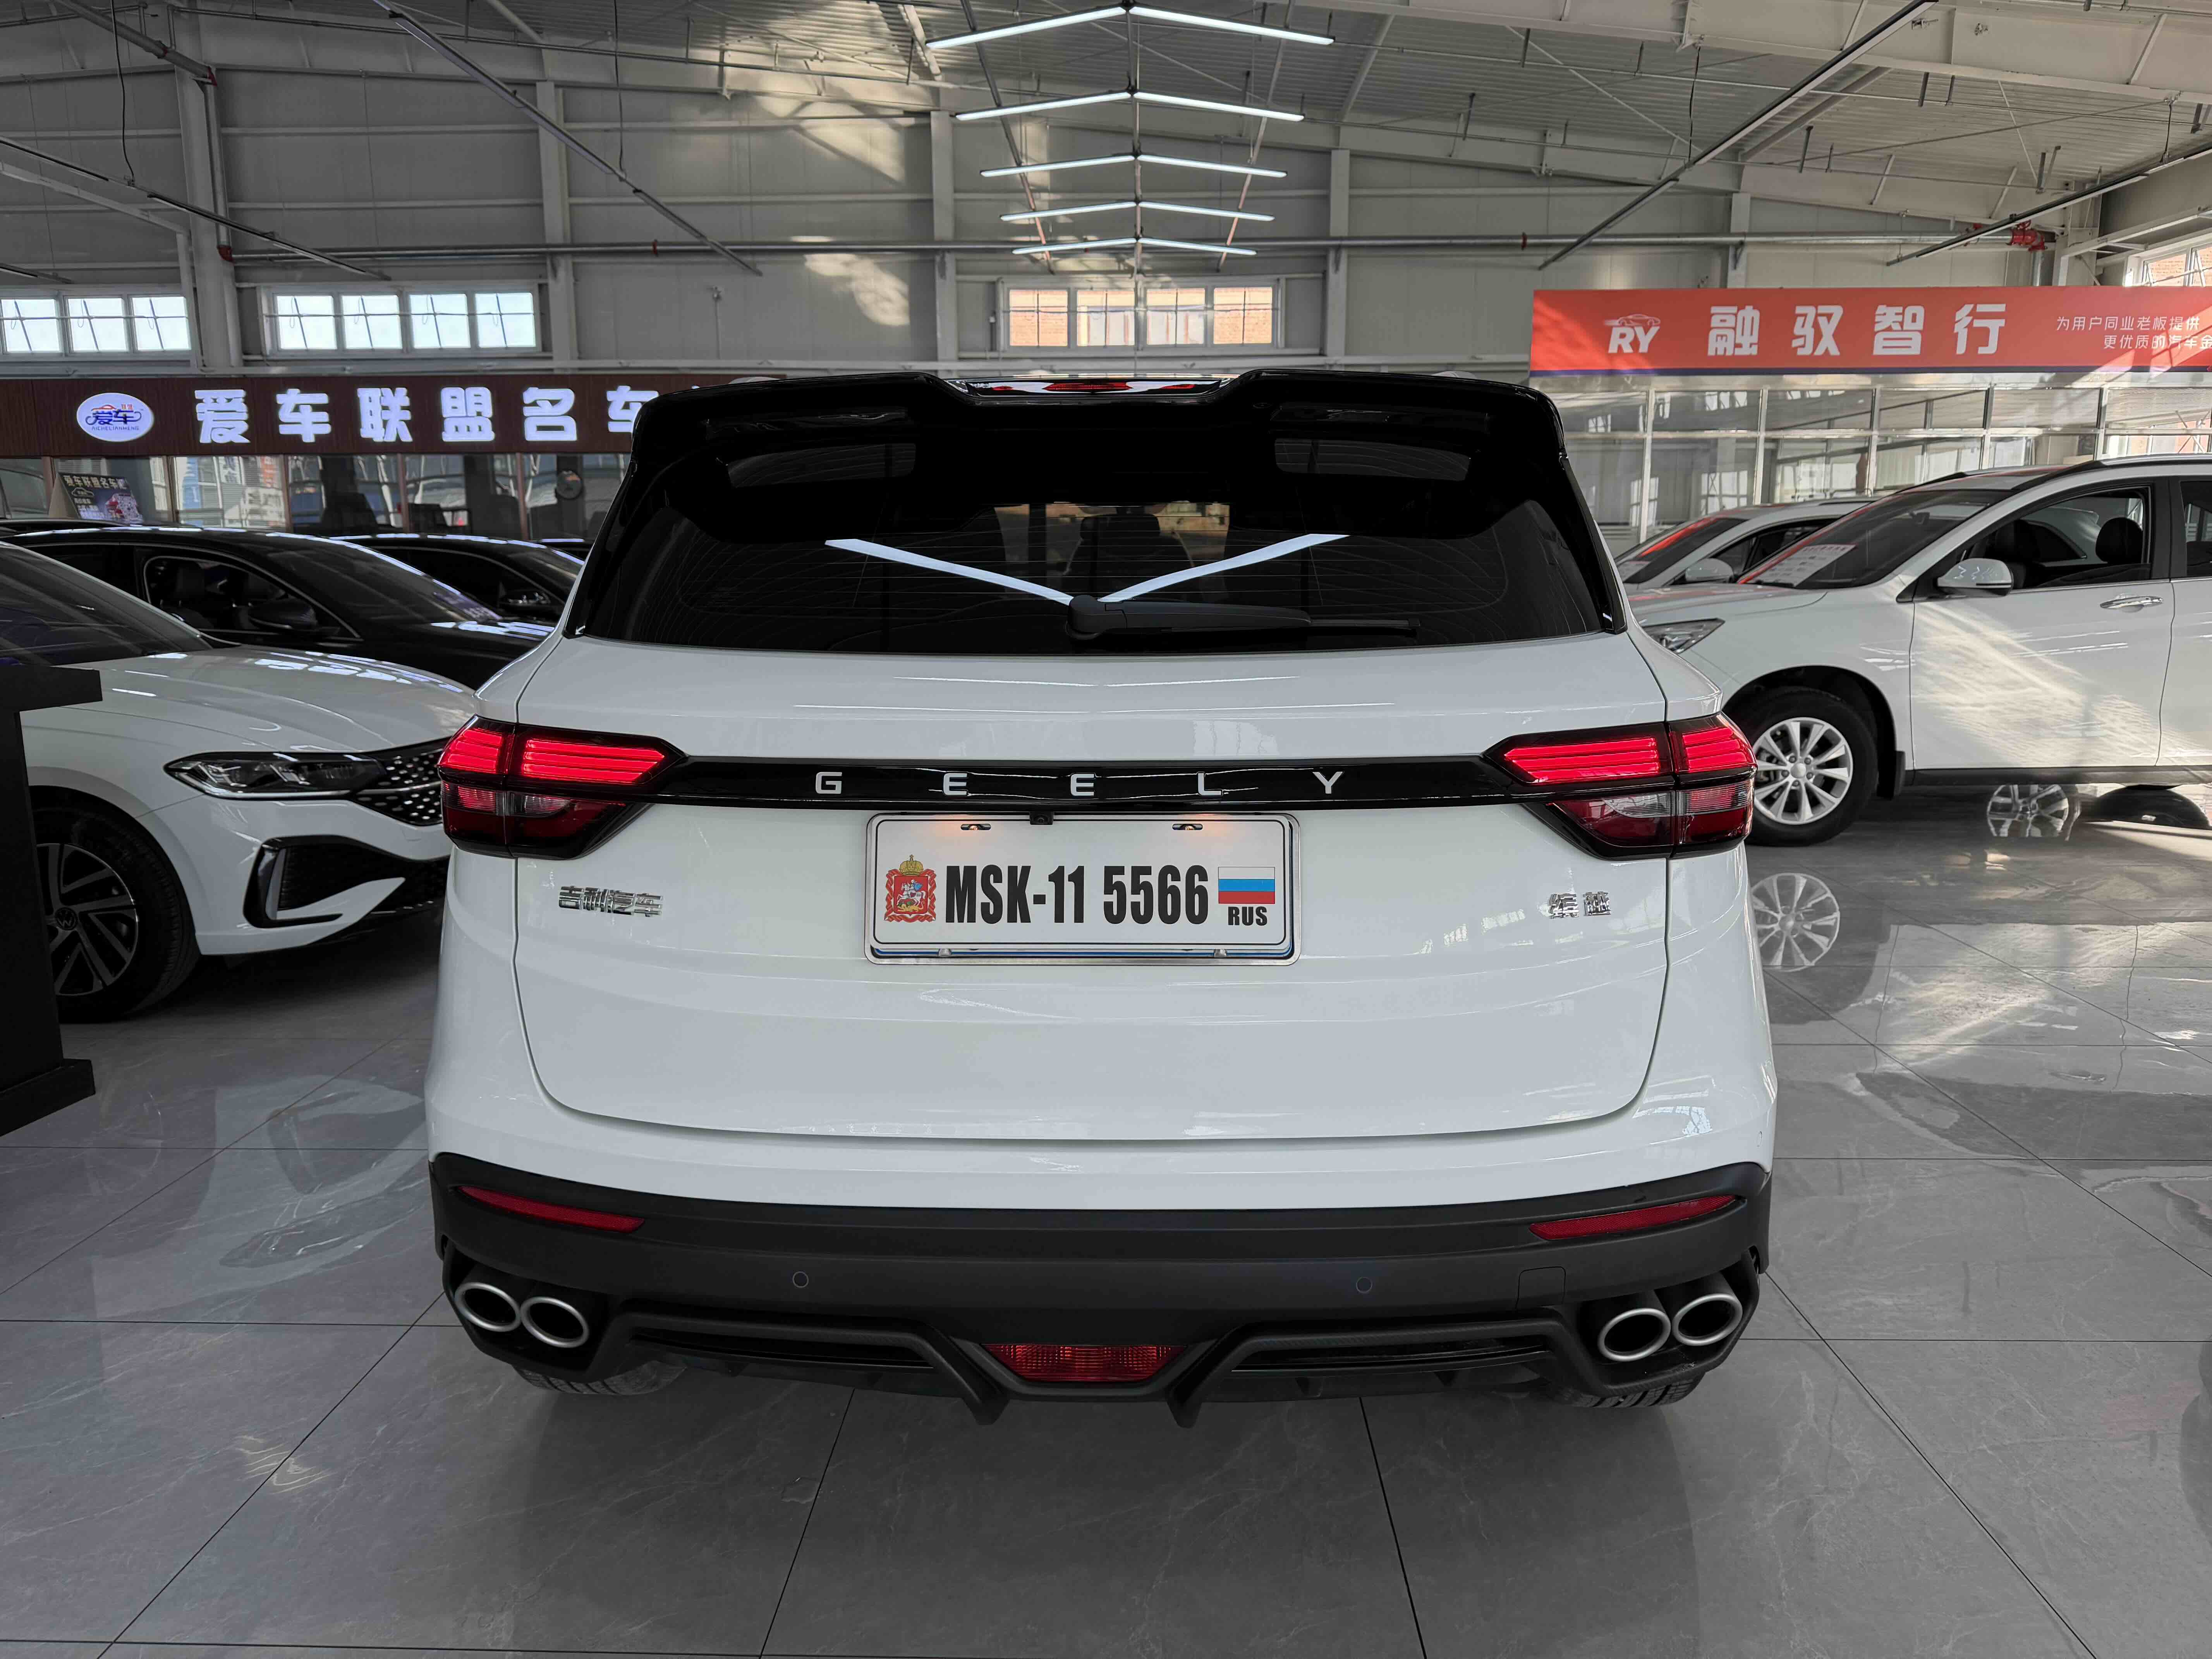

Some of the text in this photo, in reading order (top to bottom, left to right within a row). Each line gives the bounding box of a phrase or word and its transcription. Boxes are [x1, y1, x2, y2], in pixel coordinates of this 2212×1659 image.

[1707, 304, 2006, 356] 融驭智行
[2056, 316, 2200, 330] 为用户同业老板提供
[1608, 325, 1660, 354] RY
[2104, 335, 2212, 349] 更优质的汽车金
[194, 386, 658, 443] 爱车联盟名车
[815, 771, 1345, 797] GEELY
[946, 864, 1209, 925] MSK-11 5566
[1228, 906, 1268, 926] RUS
